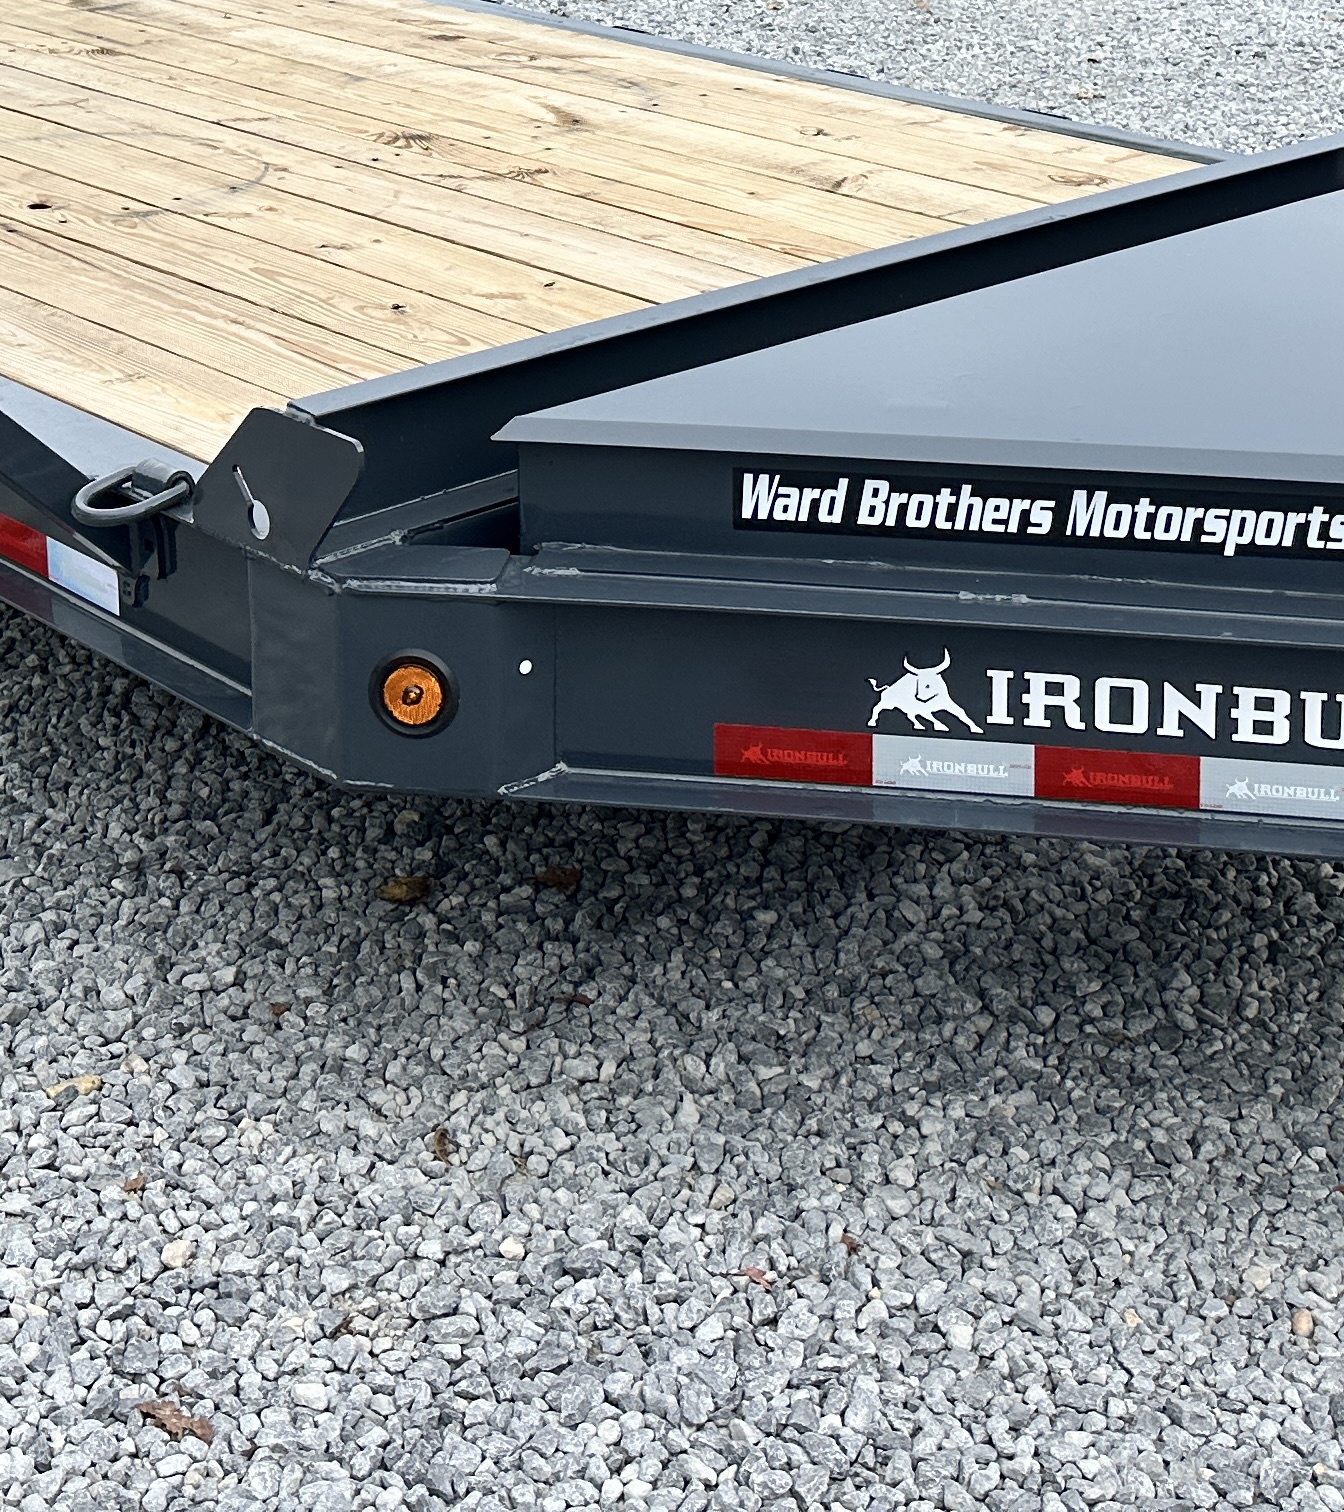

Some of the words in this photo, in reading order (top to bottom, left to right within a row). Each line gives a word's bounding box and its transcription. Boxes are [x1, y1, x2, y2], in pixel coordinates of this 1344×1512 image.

[741, 473, 849, 524] Ward
[856, 479, 1056, 535] Brothers
[767, 748, 848, 766] IRONBULL
[925, 760, 1009, 778] IRONBULL
[1089, 771, 1175, 790] IRONBULL
[1253, 783, 1340, 802] IRONBULL
